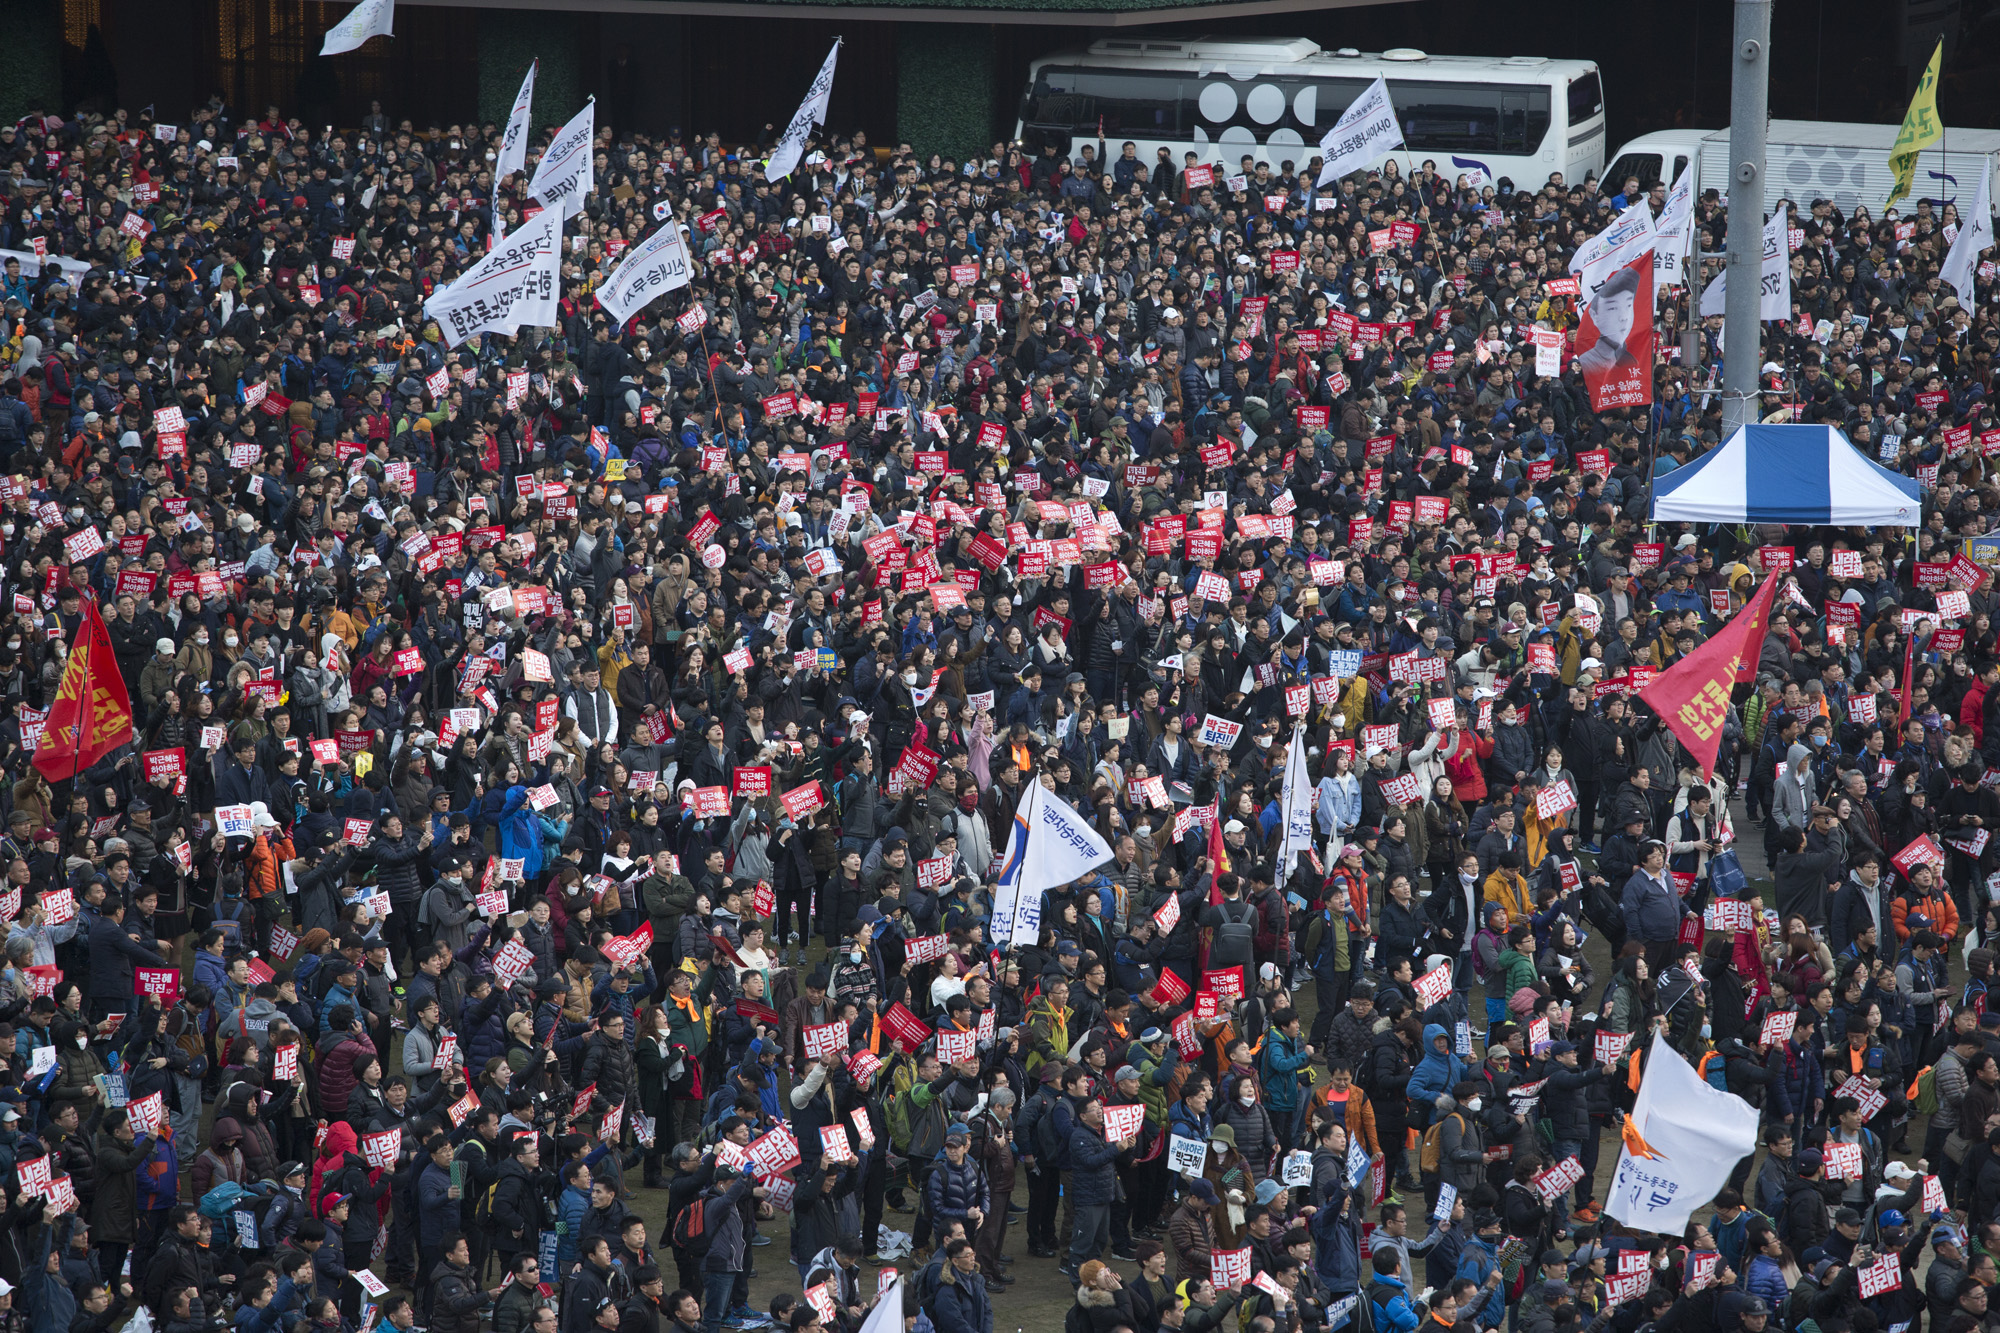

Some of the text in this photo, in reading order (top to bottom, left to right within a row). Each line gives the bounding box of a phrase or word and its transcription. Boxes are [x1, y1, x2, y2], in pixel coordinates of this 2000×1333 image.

[1329, 650, 1359, 663] 끝내자
[1206, 718, 1239, 736] 박근혜
[1205, 729, 1234, 746] 퇴진!!
[150, 754, 179, 765] 박근혜는
[151, 763, 180, 773] 하야하라
[740, 772, 766, 781] 박근혜는
[740, 781, 766, 790] 하야하라
[1043, 804, 1099, 860] 기관차승무지부
[139, 972, 172, 983] 박근혜
[144, 983, 166, 993] 퇴진
[803, 1024, 848, 1044] 내려와
[805, 1039, 848, 1057] 박근혜
[1176, 1140, 1204, 1155] 하야하라
